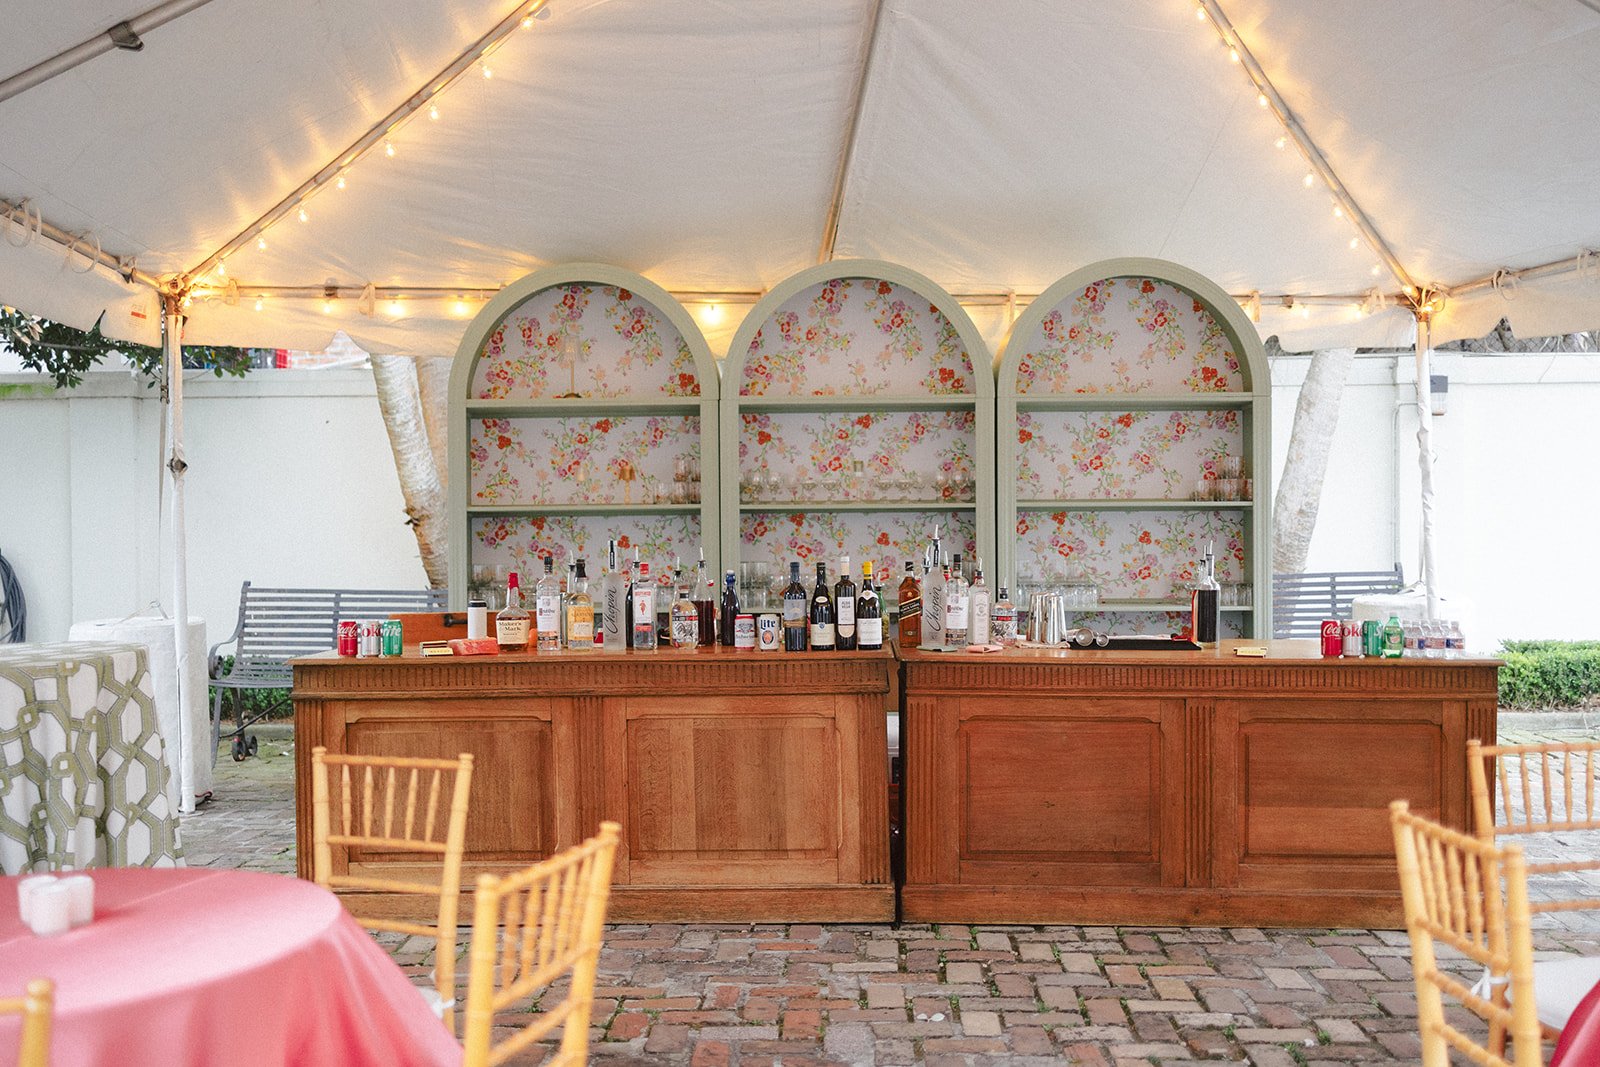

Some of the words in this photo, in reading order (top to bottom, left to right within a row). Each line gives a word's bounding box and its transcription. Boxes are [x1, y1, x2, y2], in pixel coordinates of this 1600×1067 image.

[604, 586, 620, 633] Chopin
[760, 619, 775, 630] Lite
[925, 587, 943, 632] Chopin
